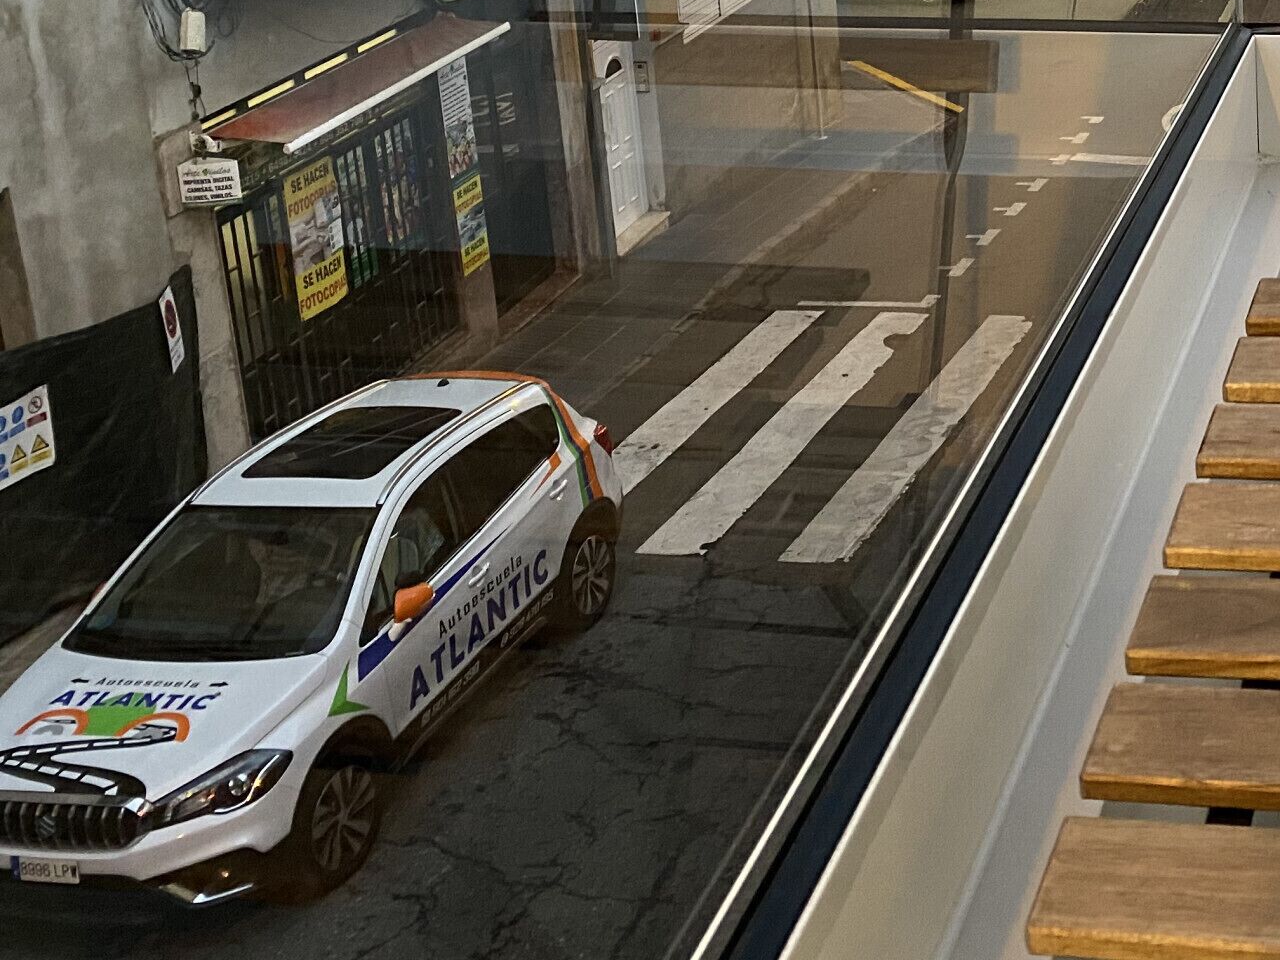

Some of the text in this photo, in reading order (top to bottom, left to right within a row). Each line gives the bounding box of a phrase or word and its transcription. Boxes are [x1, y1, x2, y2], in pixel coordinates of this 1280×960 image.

[290, 177, 302, 194] SE
[303, 162, 329, 185] HACEN
[303, 255, 342, 289] SE HACEN
[438, 555, 522, 639] Autoescuela
[410, 549, 549, 711] ATLANTIC
[95, 677, 200, 688] Autoescuela
[49, 690, 216, 710] ATLANTIC
